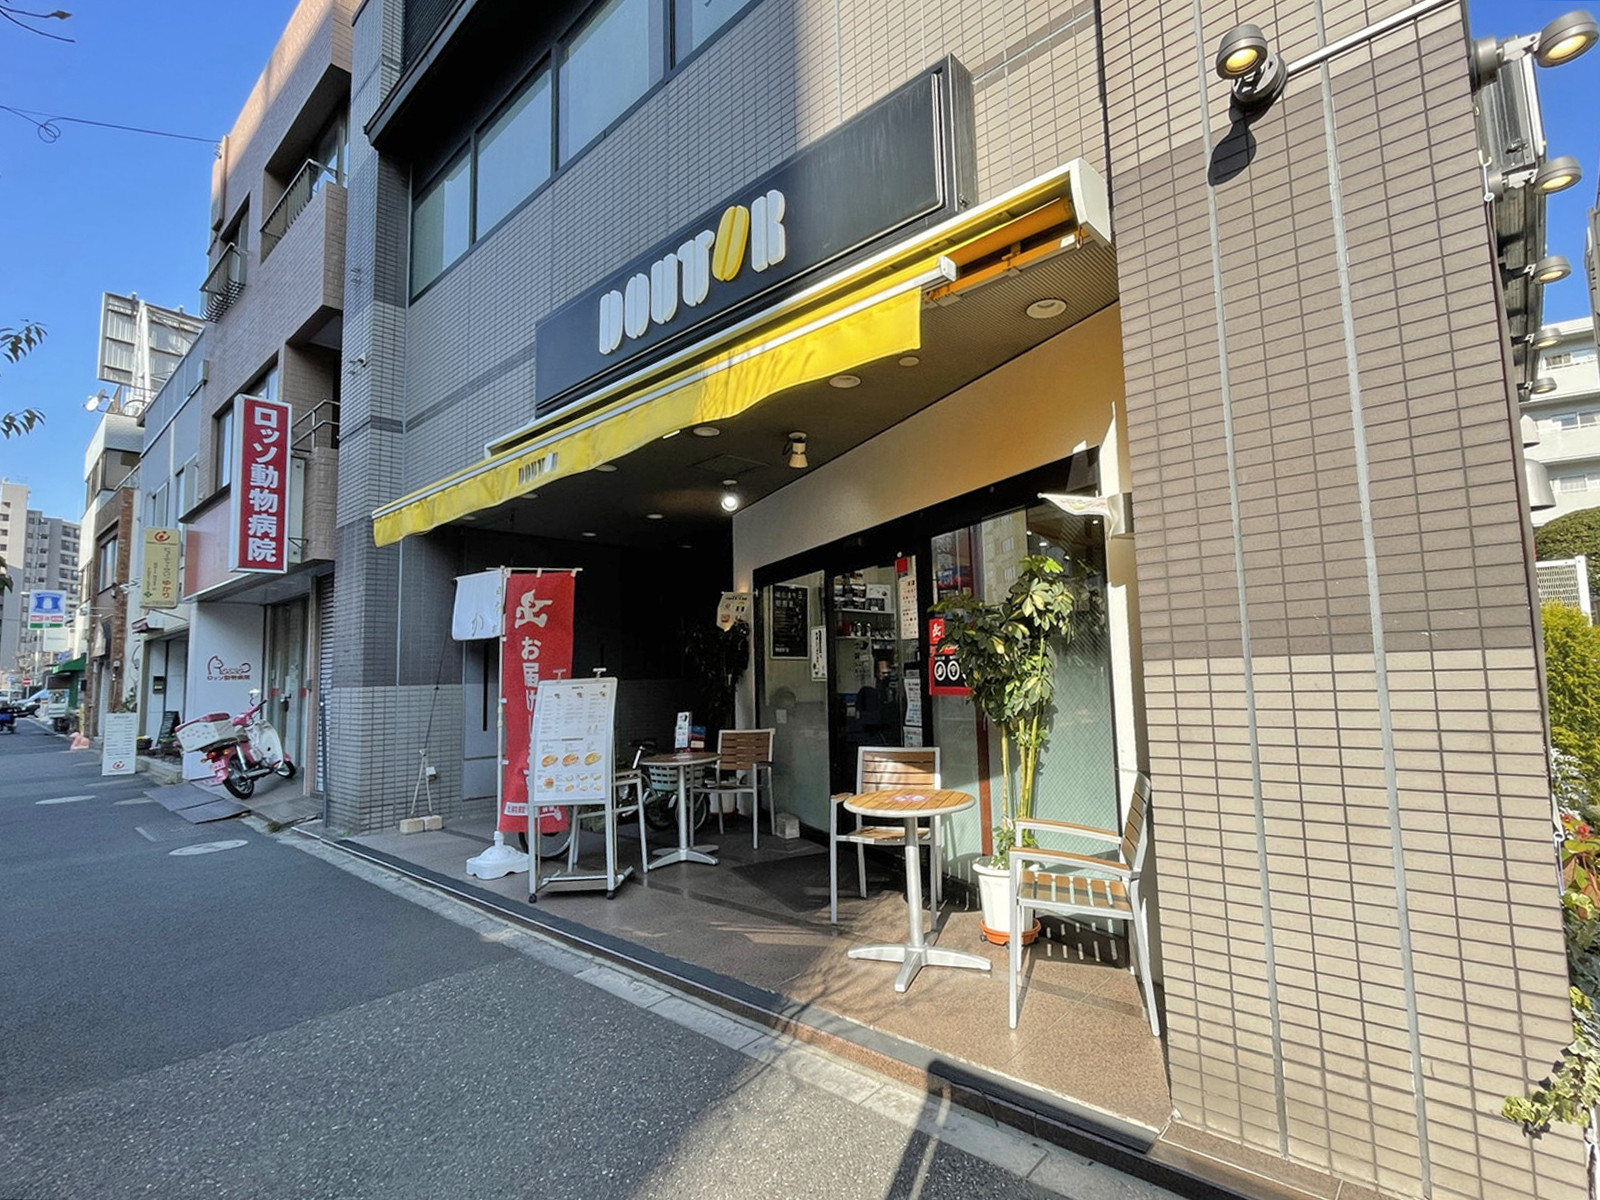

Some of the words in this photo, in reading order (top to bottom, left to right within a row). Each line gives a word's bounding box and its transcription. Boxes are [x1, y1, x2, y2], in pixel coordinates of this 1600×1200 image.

[599, 189, 786, 355] DOUTOR
[248, 406, 280, 563] ロッソ動物病院
